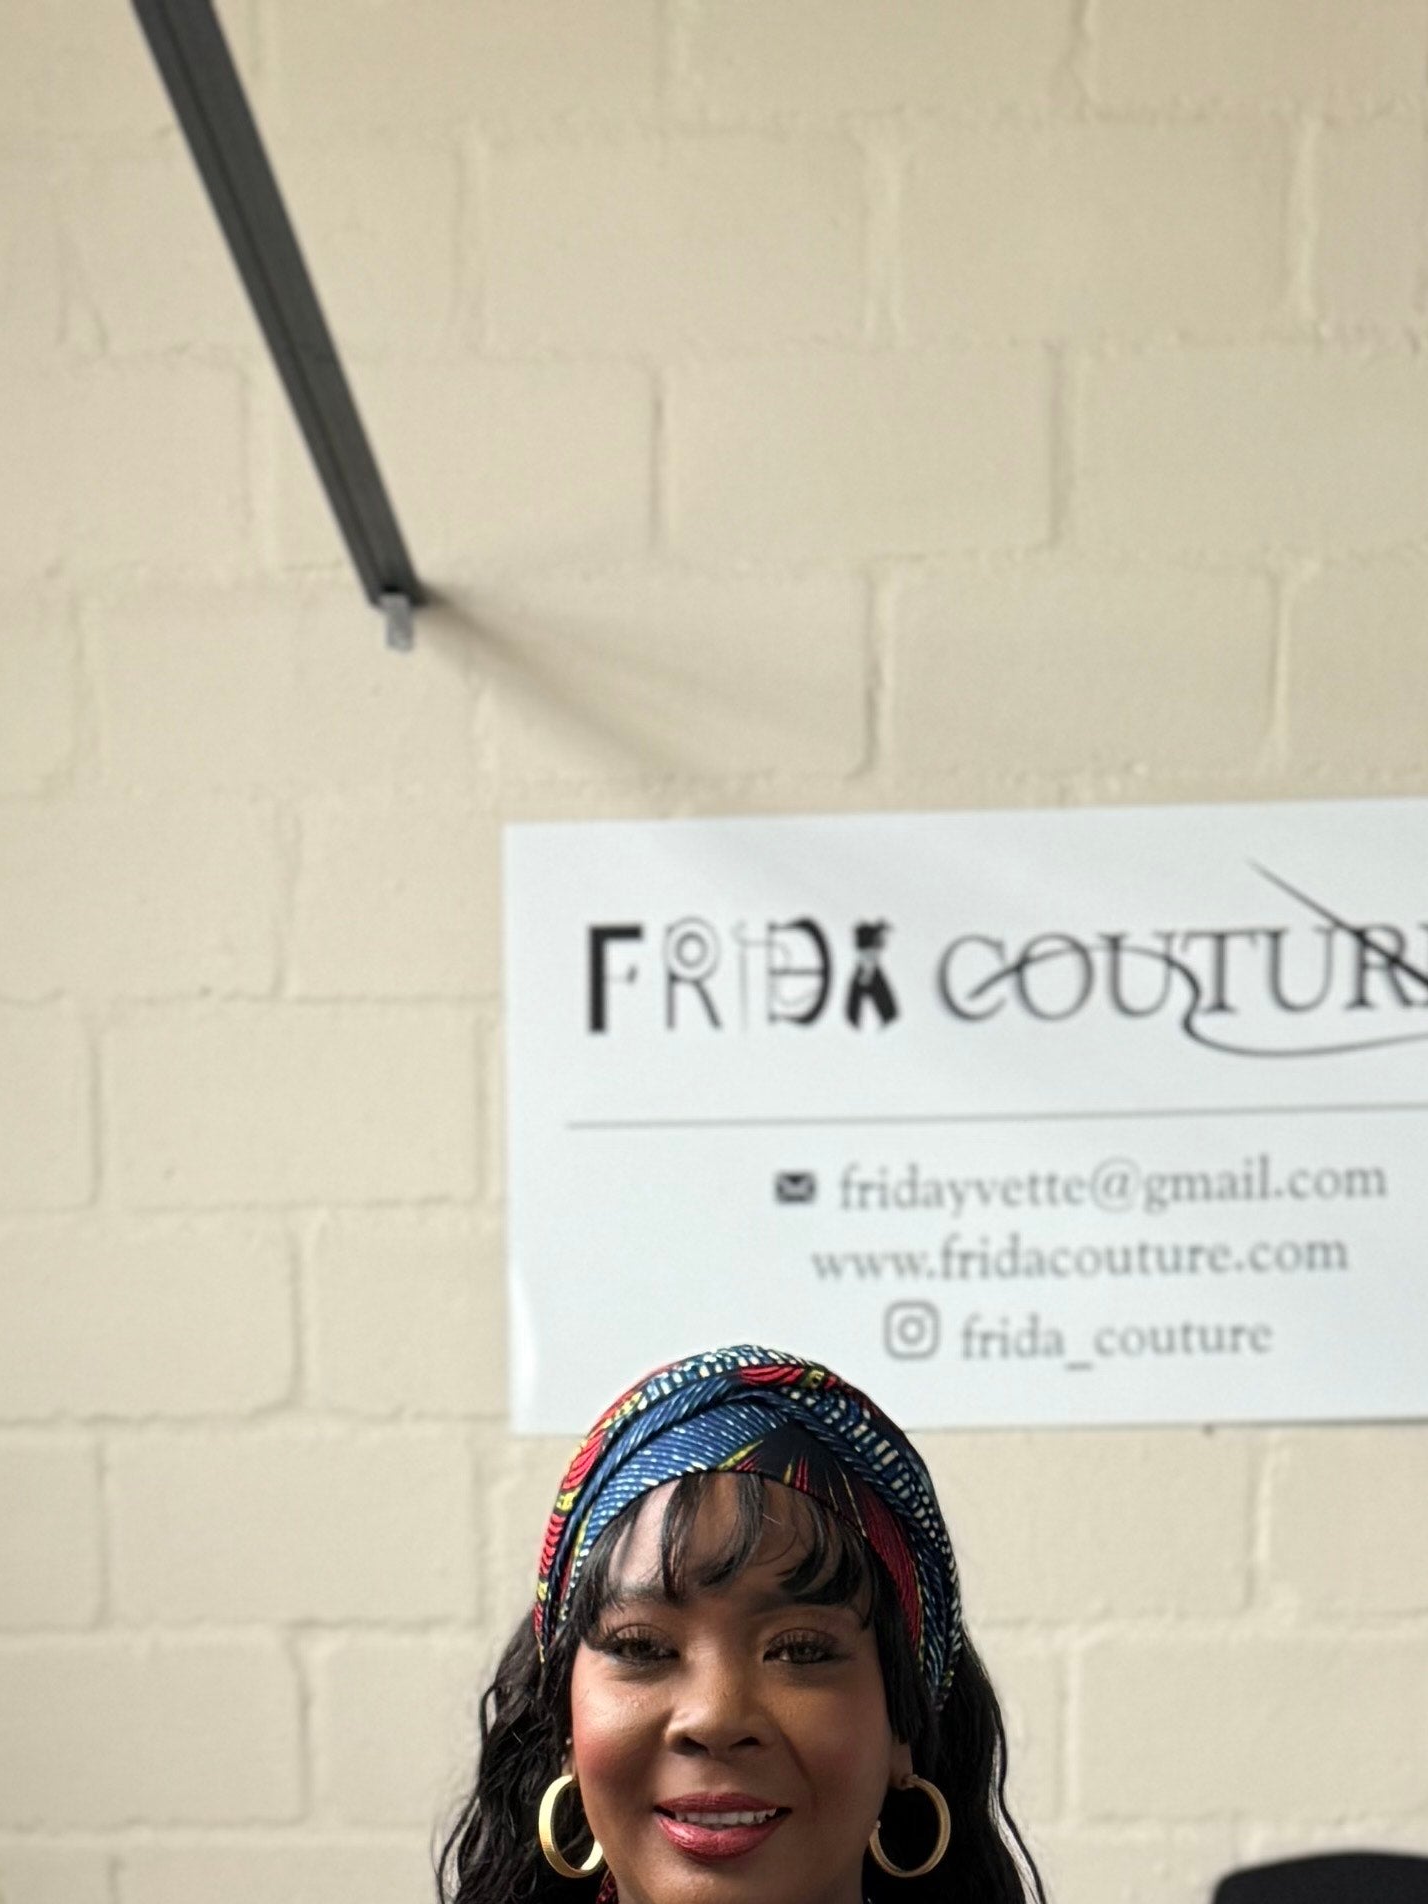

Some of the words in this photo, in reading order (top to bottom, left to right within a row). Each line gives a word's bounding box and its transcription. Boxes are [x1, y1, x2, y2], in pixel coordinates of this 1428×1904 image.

[587, 914, 901, 1034] FRIDA
[839, 1152, 1388, 1219] fridayvette@gmail.com
[810, 1231, 1350, 1281] www.fridacouture.com
[961, 1311, 1274, 1371] frida_couture
